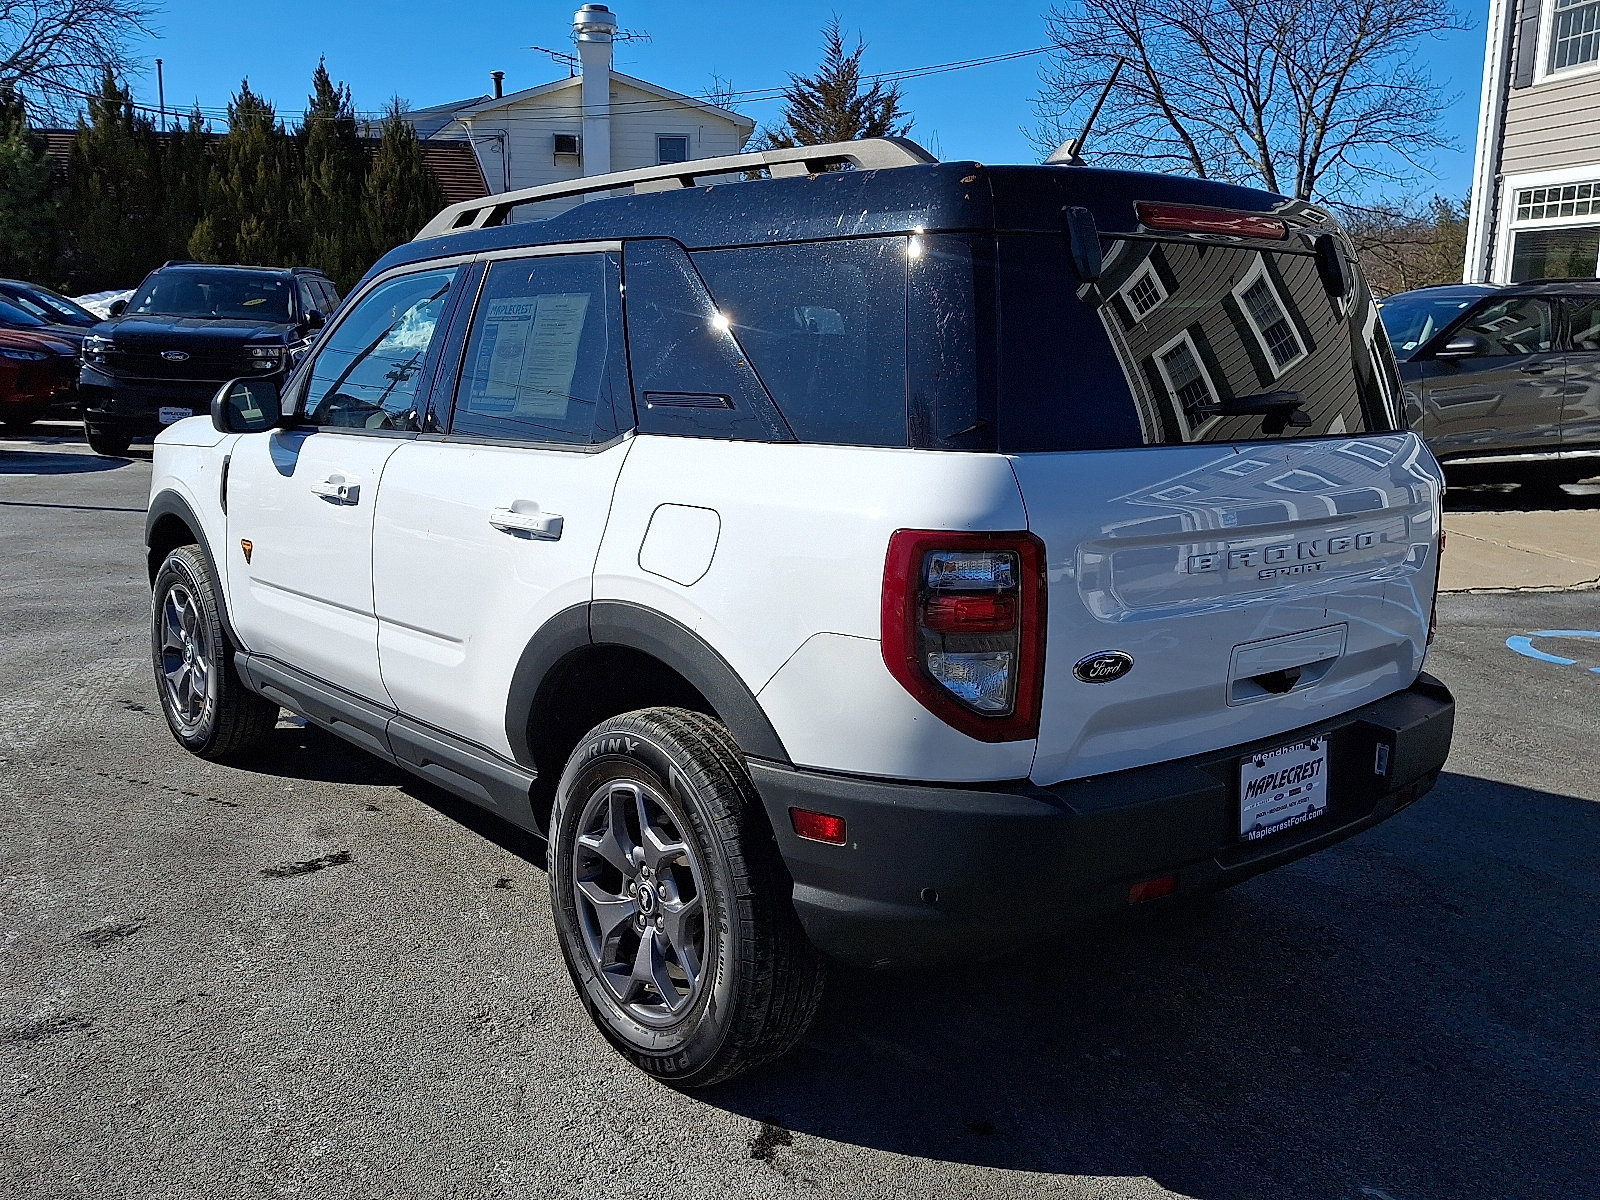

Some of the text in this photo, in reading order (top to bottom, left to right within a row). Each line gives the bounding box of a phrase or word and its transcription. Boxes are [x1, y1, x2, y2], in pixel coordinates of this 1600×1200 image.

[490, 304, 533, 315] MAPLECREST
[1258, 560, 1327, 580] SPORT
[1089, 658, 1122, 677] Ford
[1244, 757, 1323, 800] MAPLECREST
[1248, 808, 1323, 840] MaplecrestFord.com
